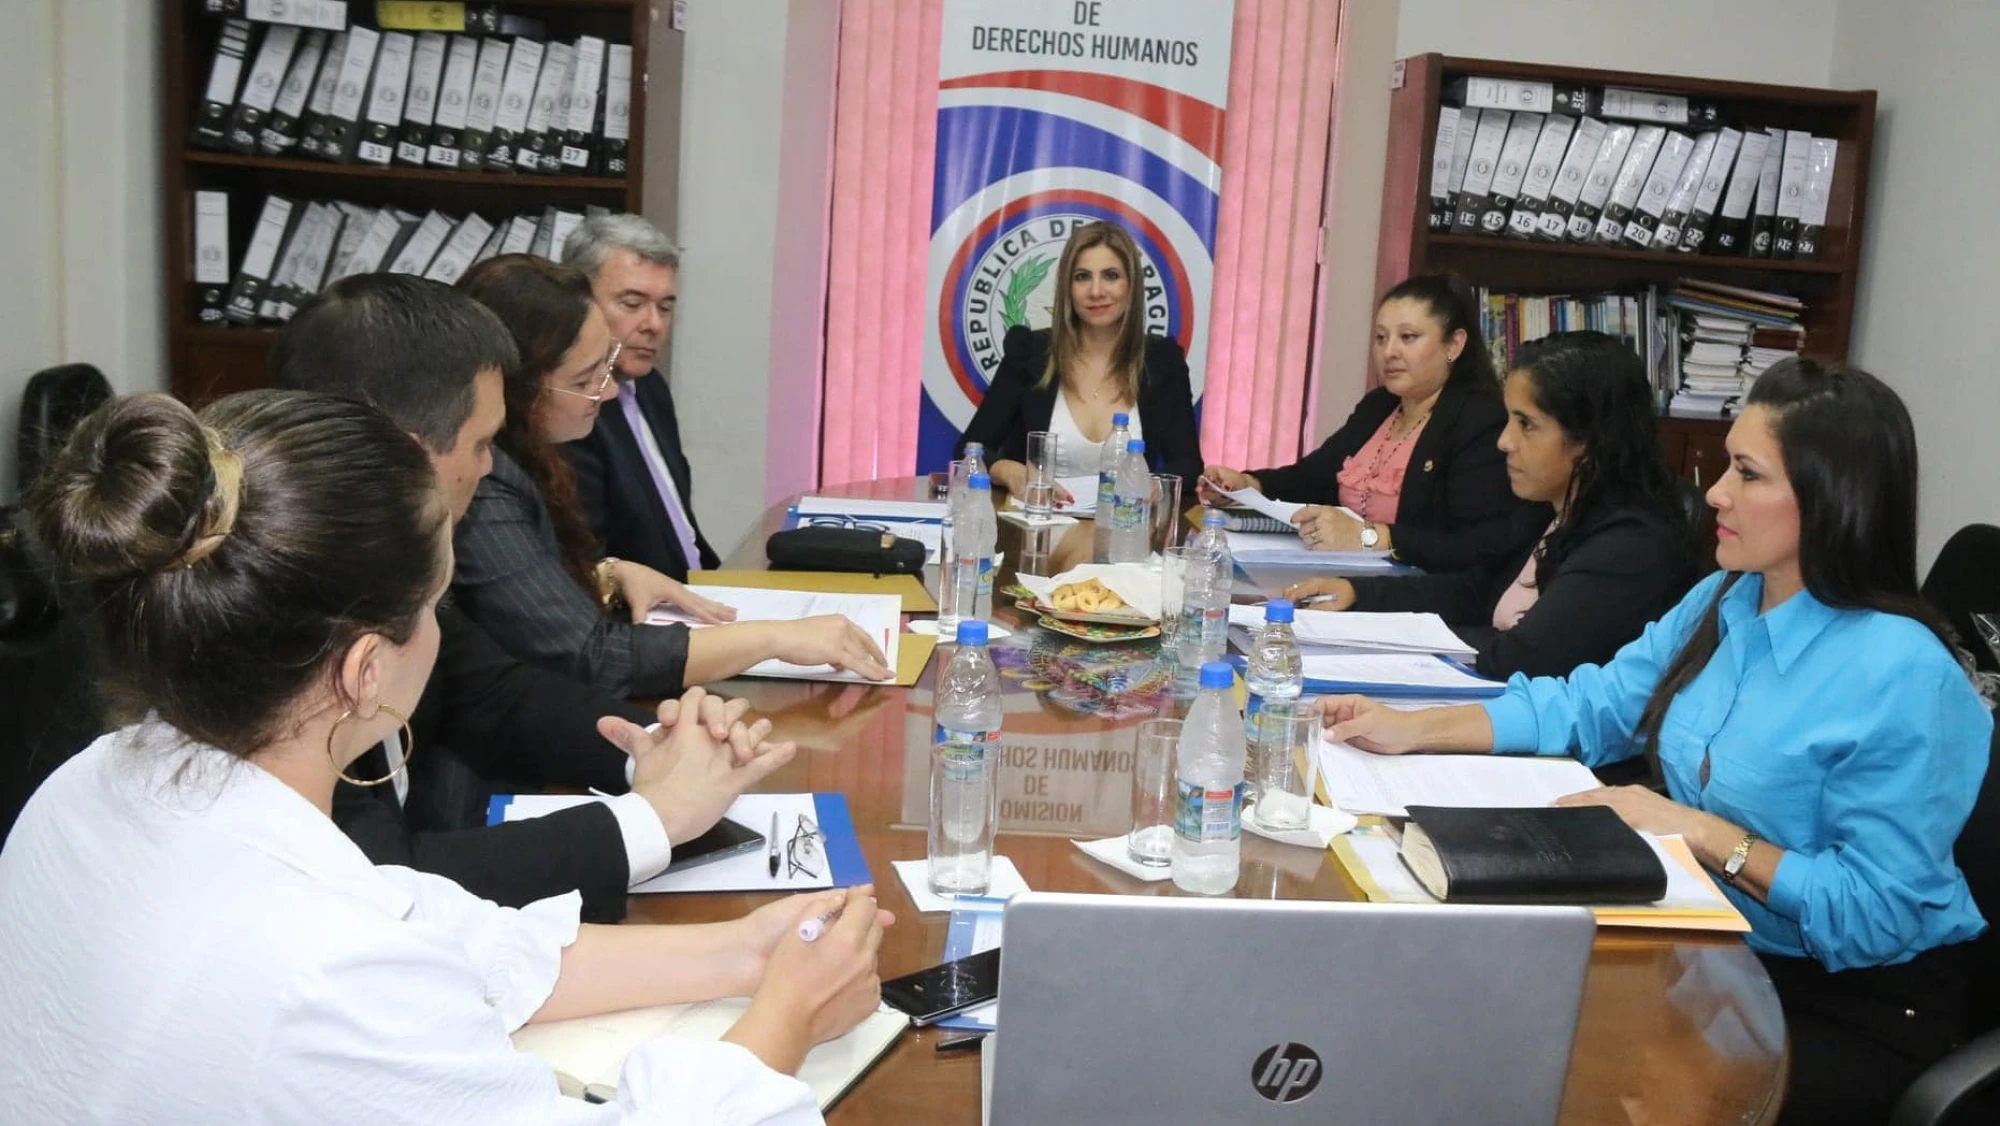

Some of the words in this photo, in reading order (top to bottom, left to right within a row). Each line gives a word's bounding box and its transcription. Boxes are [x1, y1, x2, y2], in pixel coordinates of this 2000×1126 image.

[1073, 1, 1101, 26] DE
[972, 26, 1085, 58] DERECHOS
[1091, 34, 1199, 67] HUMANOS
[1516, 215, 1531, 228] 16
[1545, 218, 1560, 230] 17
[1576, 221, 1588, 233] 18
[1605, 223, 1618, 235] 19
[1631, 227, 1646, 240] 20
[1663, 229, 1676, 242] 21
[969, 229, 1038, 371] REPUBLICA
[1257, 1042, 1318, 1102] hp
